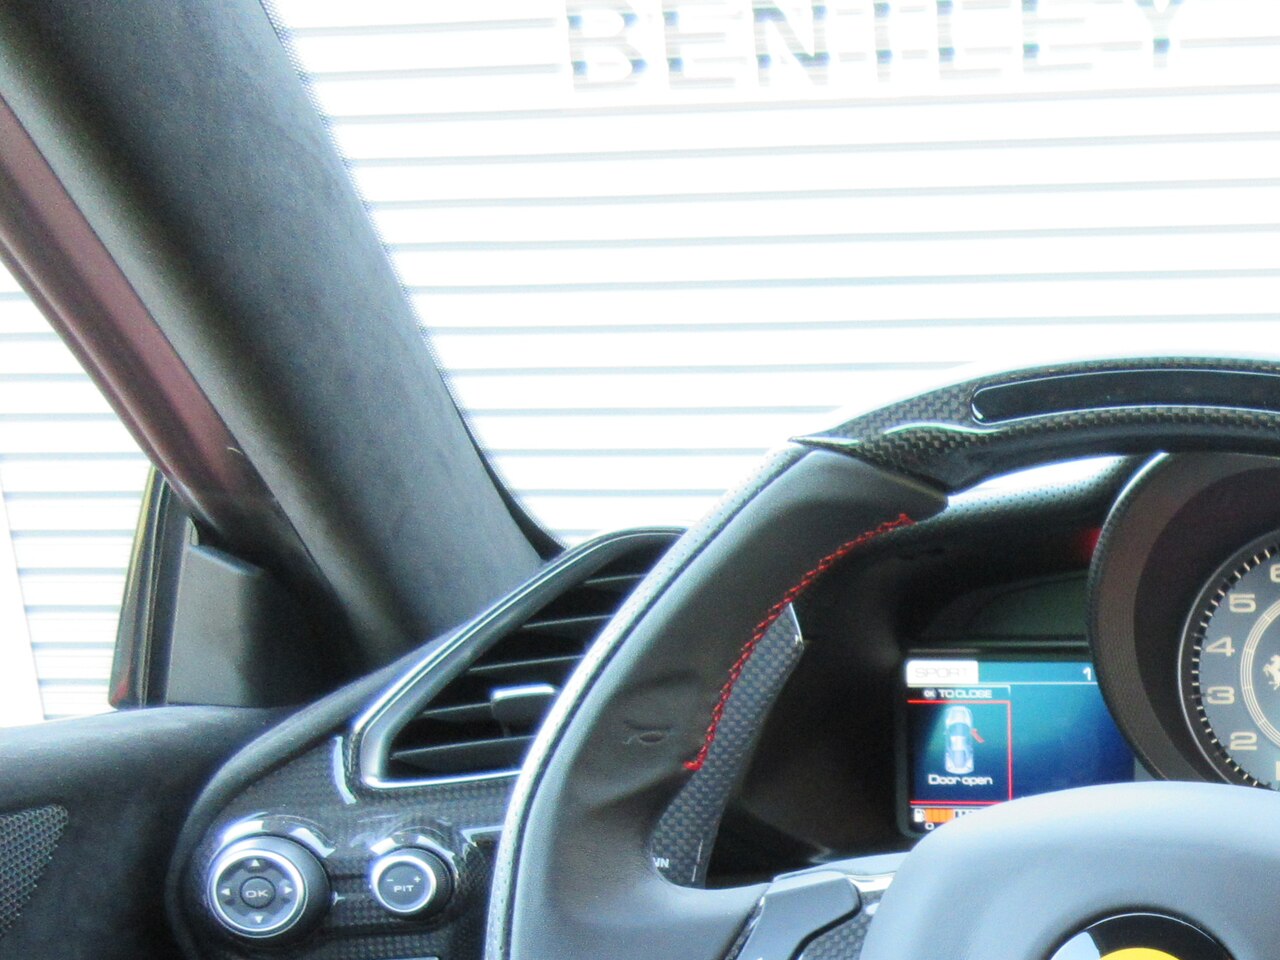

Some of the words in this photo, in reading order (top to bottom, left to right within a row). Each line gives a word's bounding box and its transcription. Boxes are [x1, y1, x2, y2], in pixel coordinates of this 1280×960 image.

[1229, 593, 1257, 613] 5
[1206, 636, 1236, 657] 4
[938, 689, 954, 698] TO
[955, 689, 993, 699] CLOSE
[1206, 686, 1236, 705] 3
[1230, 731, 1258, 751] 2
[928, 774, 961, 786] Door
[961, 776, 994, 787] open
[245, 889, 268, 899] OK
[393, 884, 414, 893] PIT
